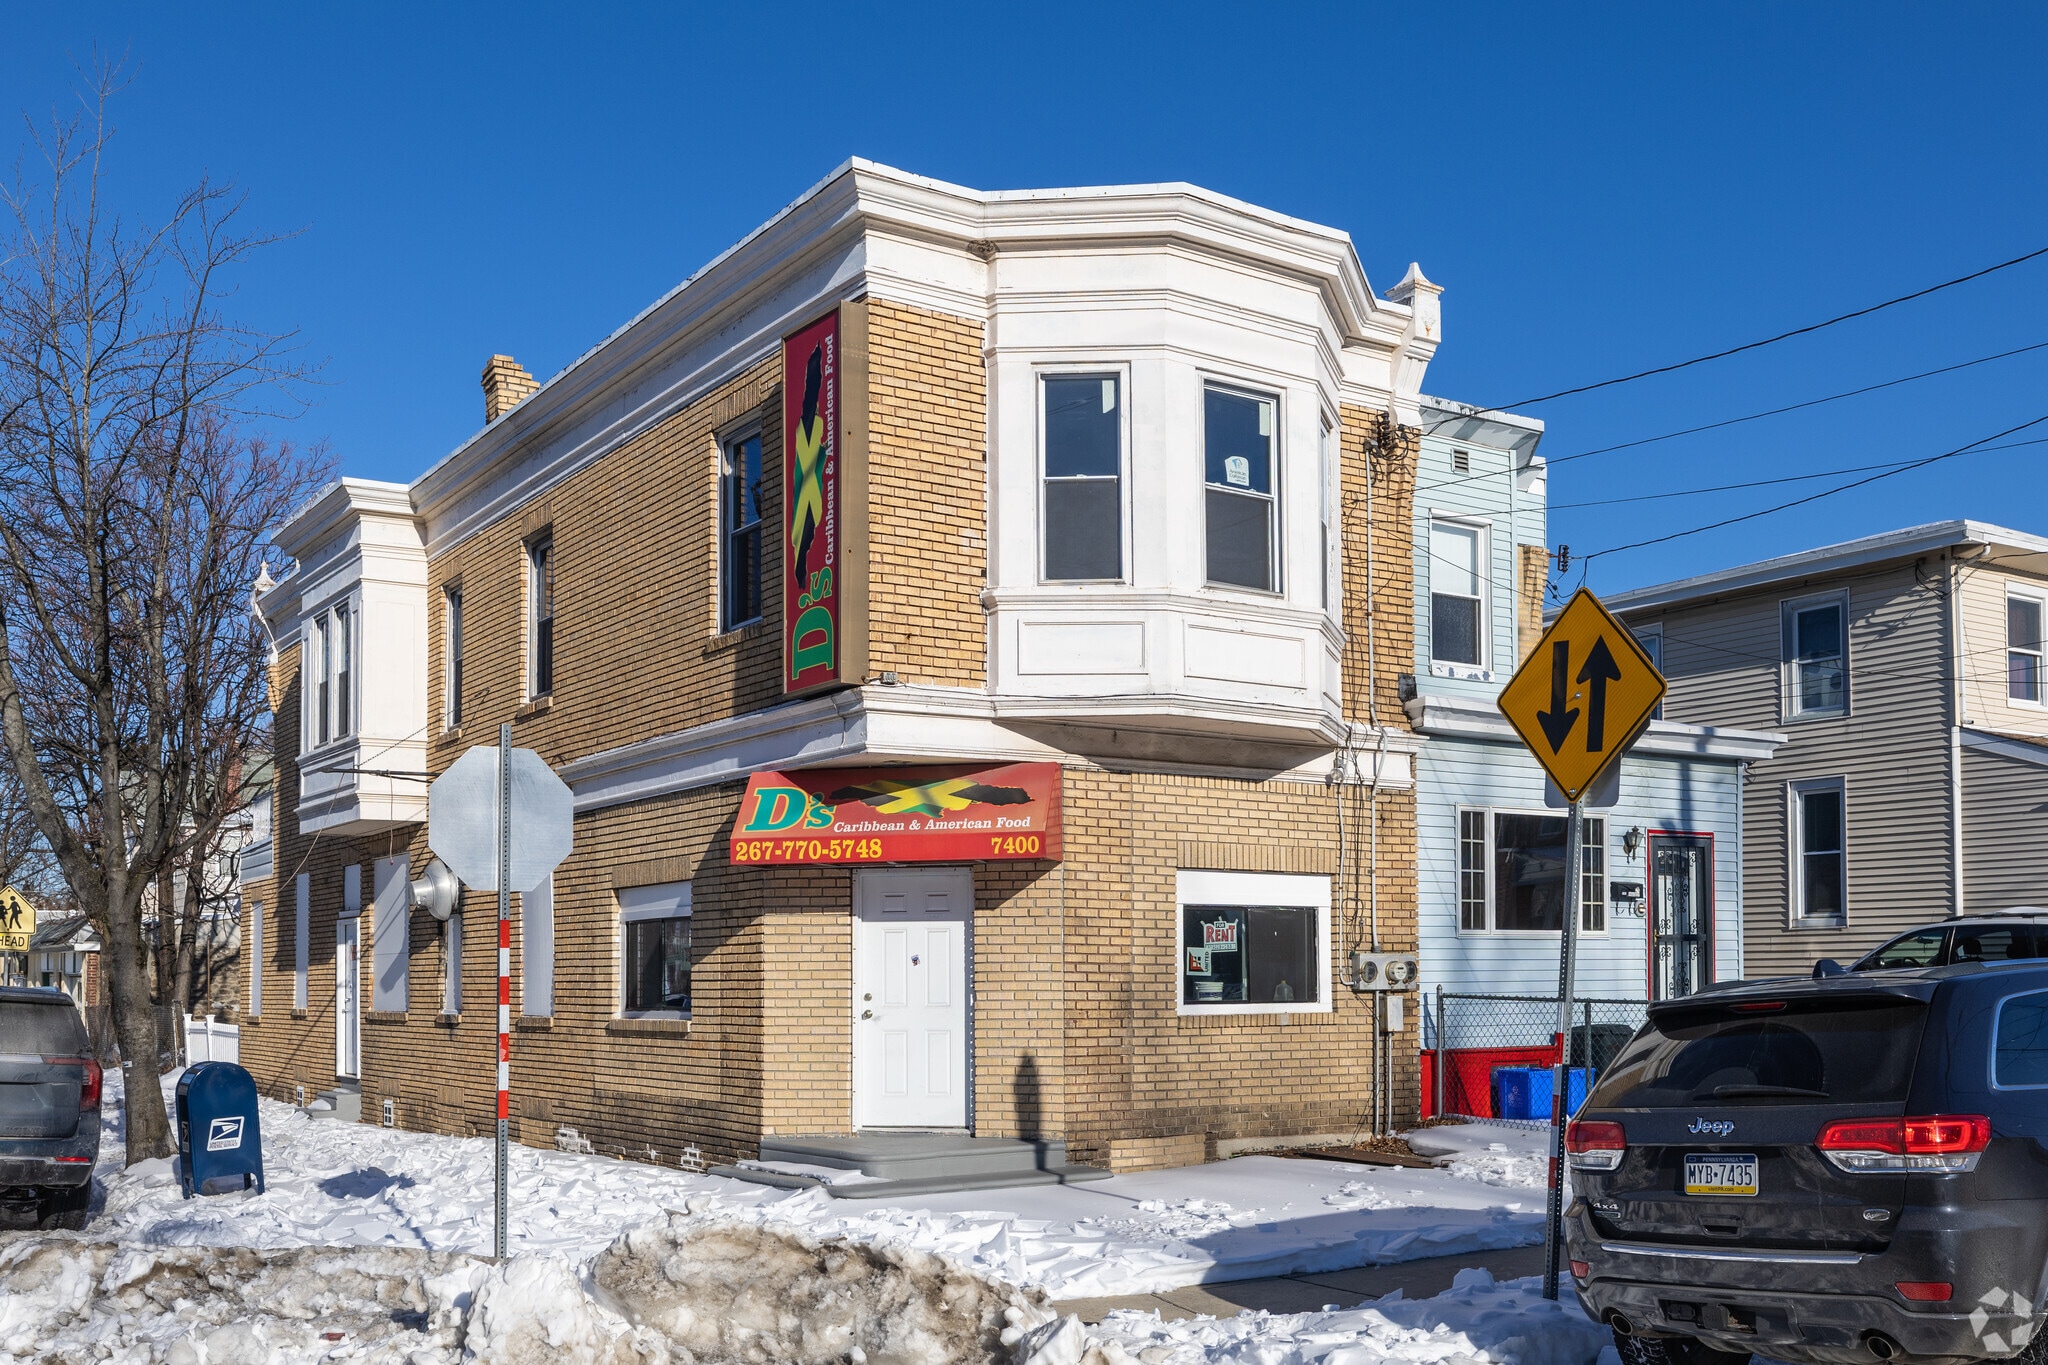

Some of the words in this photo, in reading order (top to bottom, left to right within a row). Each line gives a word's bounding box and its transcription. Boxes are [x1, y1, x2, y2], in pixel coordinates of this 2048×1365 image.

[825, 333, 833, 376] Food
[825, 378, 834, 456] American
[825, 461, 833, 474] &
[825, 478, 833, 564] Caribbean
[792, 566, 834, 681] D's
[742, 786, 837, 832] D's
[833, 821, 905, 833] Caribbean
[909, 819, 921, 830] &
[924, 818, 992, 830] American
[995, 816, 1031, 828] Food
[735, 839, 882, 861] 267-770-5748
[991, 835, 1040, 855] 7400
[1206, 925, 1235, 942] RENT
[1687, 1116, 1735, 1137] Jeep
[1593, 1202, 1619, 1210] 4x4
